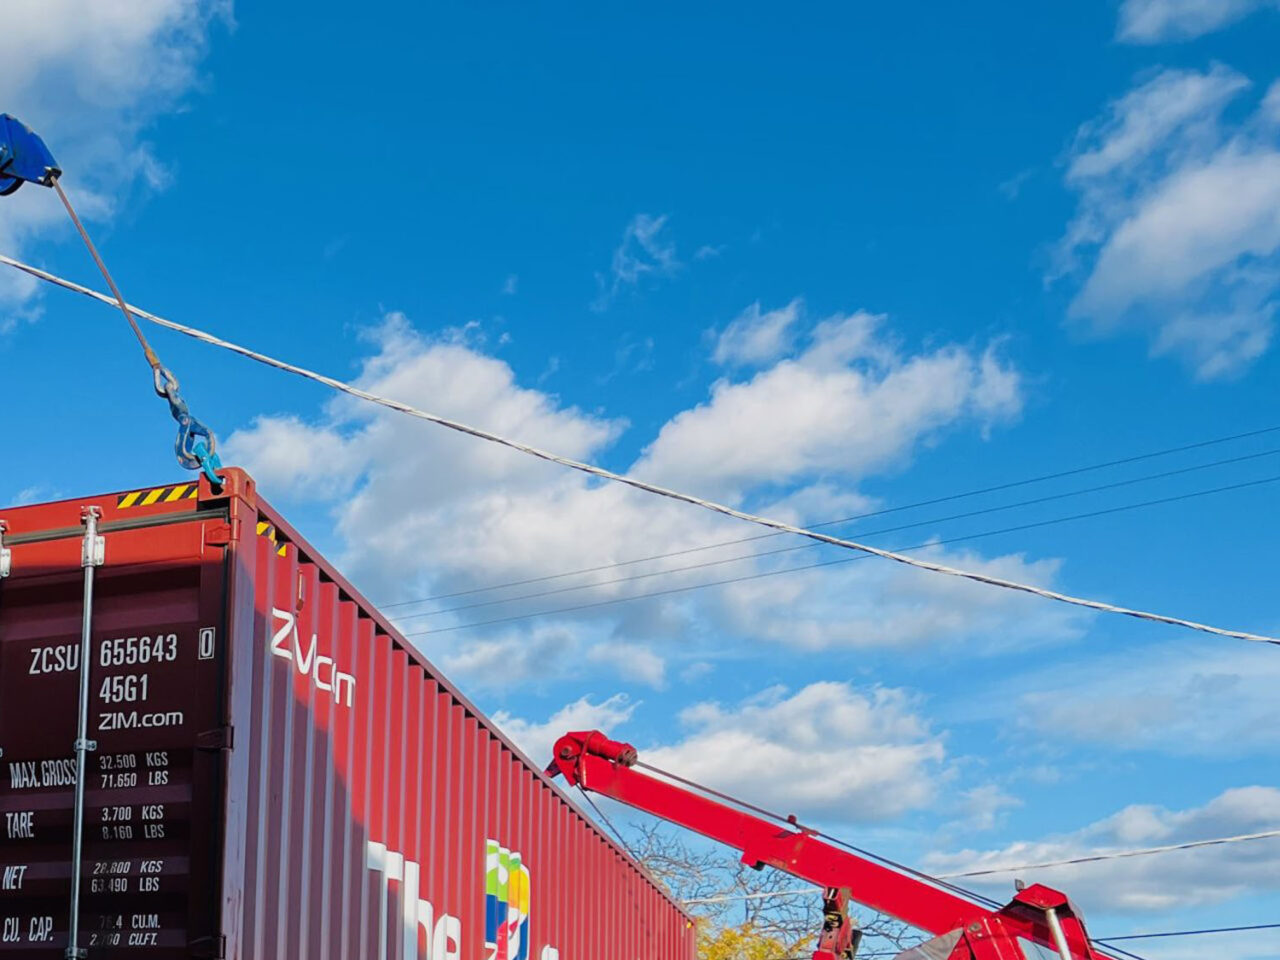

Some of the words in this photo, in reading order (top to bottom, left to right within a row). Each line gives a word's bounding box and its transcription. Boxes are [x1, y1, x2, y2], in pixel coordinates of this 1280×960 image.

[28, 643, 80, 675] ZCSU
[99, 633, 178, 667] 655643
[200, 629, 213, 658] 0
[99, 673, 148, 704] 45G1
[98, 710, 183, 731] ZIM.com
[99, 753, 137, 771] 32.500
[145, 751, 169, 767] KGS
[101, 772, 138, 789] 71.650
[147, 770, 169, 786] LBS
[101, 806, 132, 822] 3.700
[141, 804, 164, 820] KGS
[5, 811, 35, 839] TARE
[102, 825, 133, 840] 8.160
[144, 823, 165, 839] LBS
[140, 860, 163, 873] KGS
[2, 865, 28, 890] NET
[139, 876, 160, 892] LBS
[2, 916, 21, 942] CU.
[28, 915, 54, 942] CAP.
